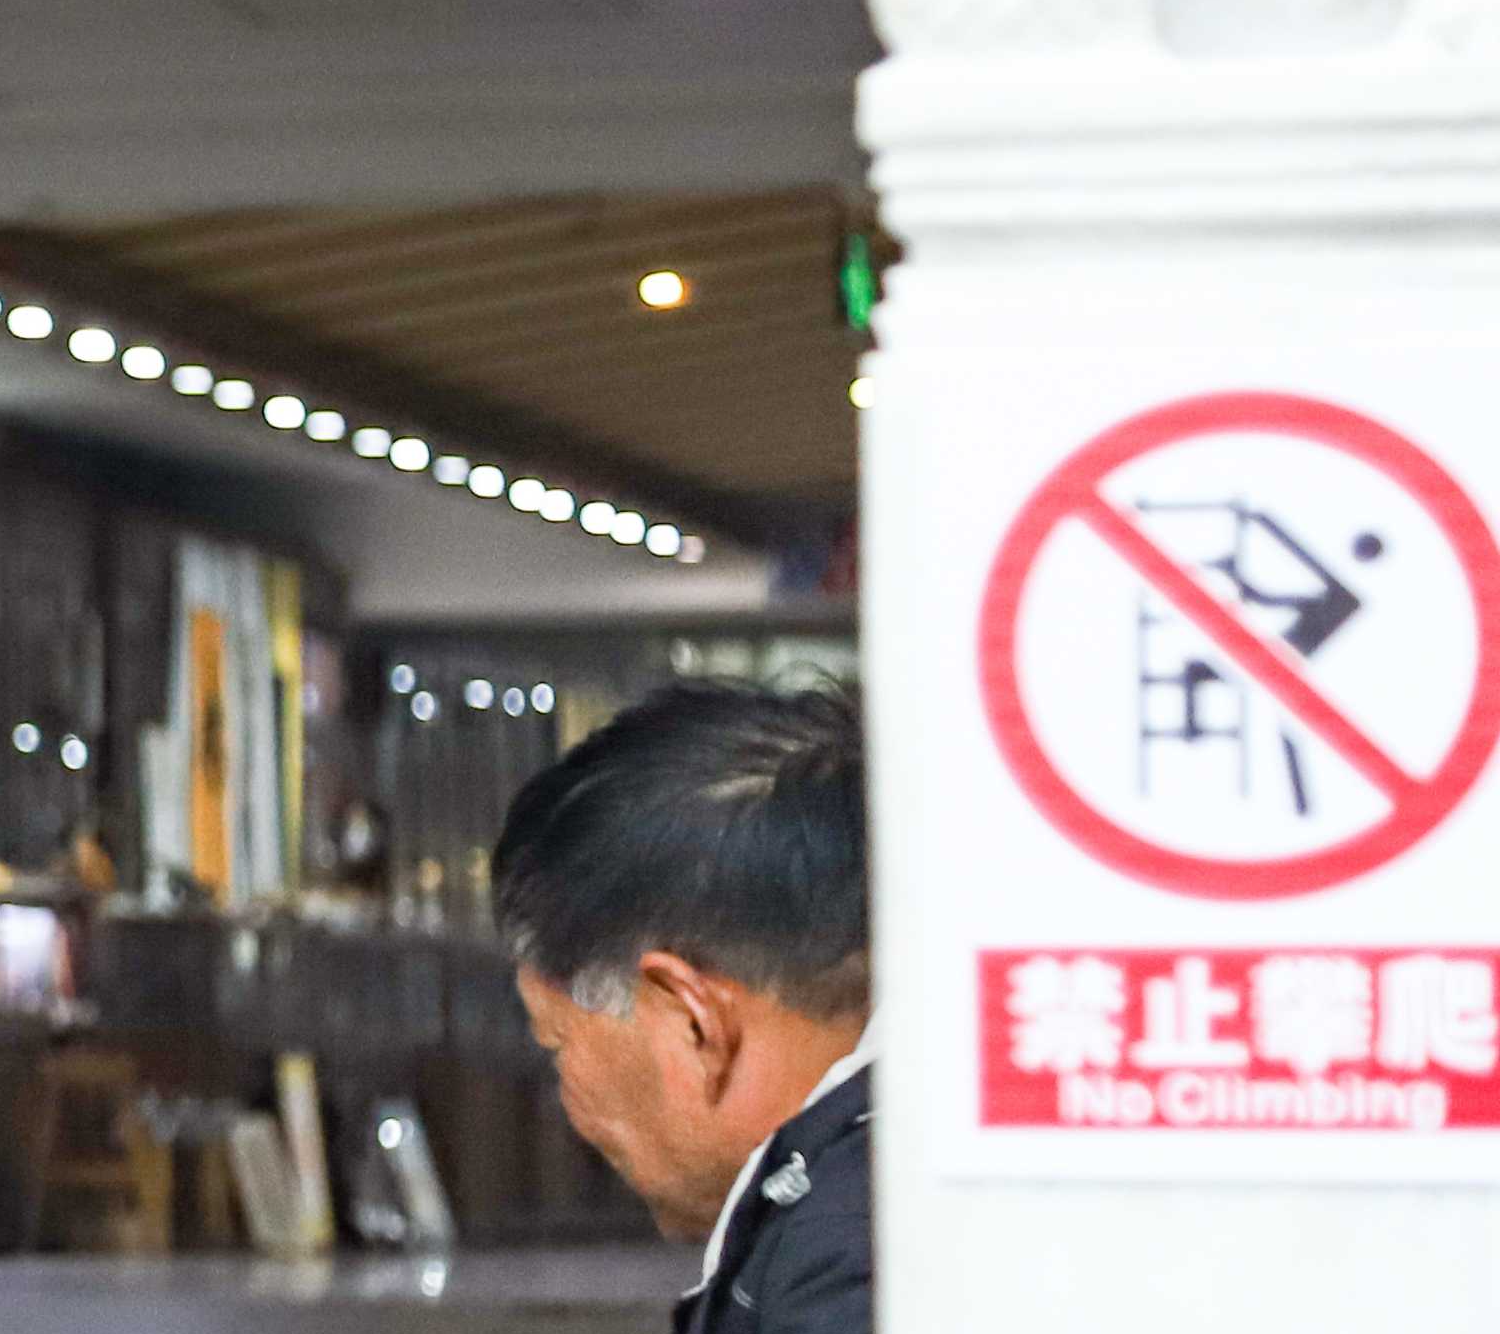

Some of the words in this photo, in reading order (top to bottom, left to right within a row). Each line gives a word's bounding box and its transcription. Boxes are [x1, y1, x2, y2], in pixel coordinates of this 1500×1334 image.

[1006, 956, 1498, 1074] 禁止攀爬
[1059, 1073, 1154, 1123] No
[1157, 1071, 1448, 1130] Climbing
